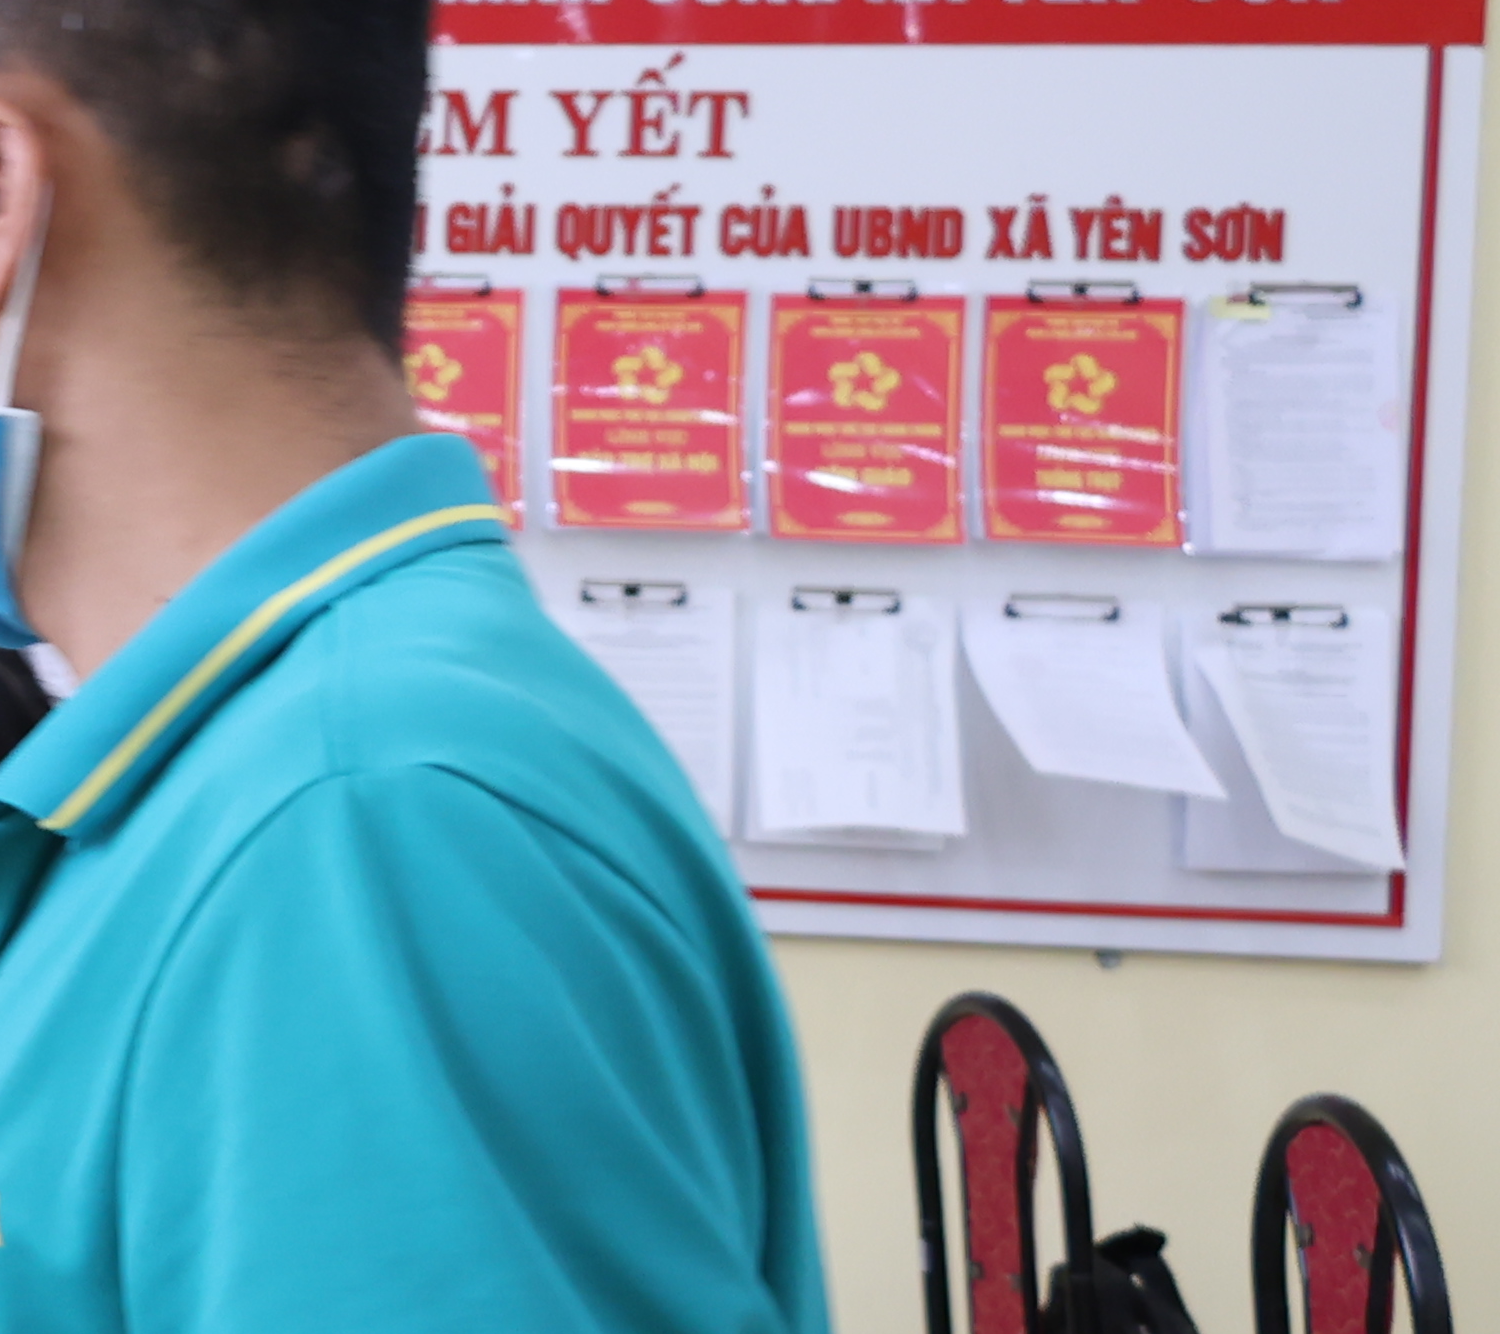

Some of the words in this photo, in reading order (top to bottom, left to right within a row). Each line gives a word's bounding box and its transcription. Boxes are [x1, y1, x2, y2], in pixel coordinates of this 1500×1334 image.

[550, 53, 748, 159] YẾT
[446, 183, 535, 255] GIẢI
[556, 183, 699, 260] QUYẾT
[719, 186, 809, 258] CỦA
[834, 205, 964, 259] UBND
[986, 194, 1053, 259] XÃ
[1071, 195, 1162, 261] YÊN
[1183, 203, 1285, 262] SƠN
